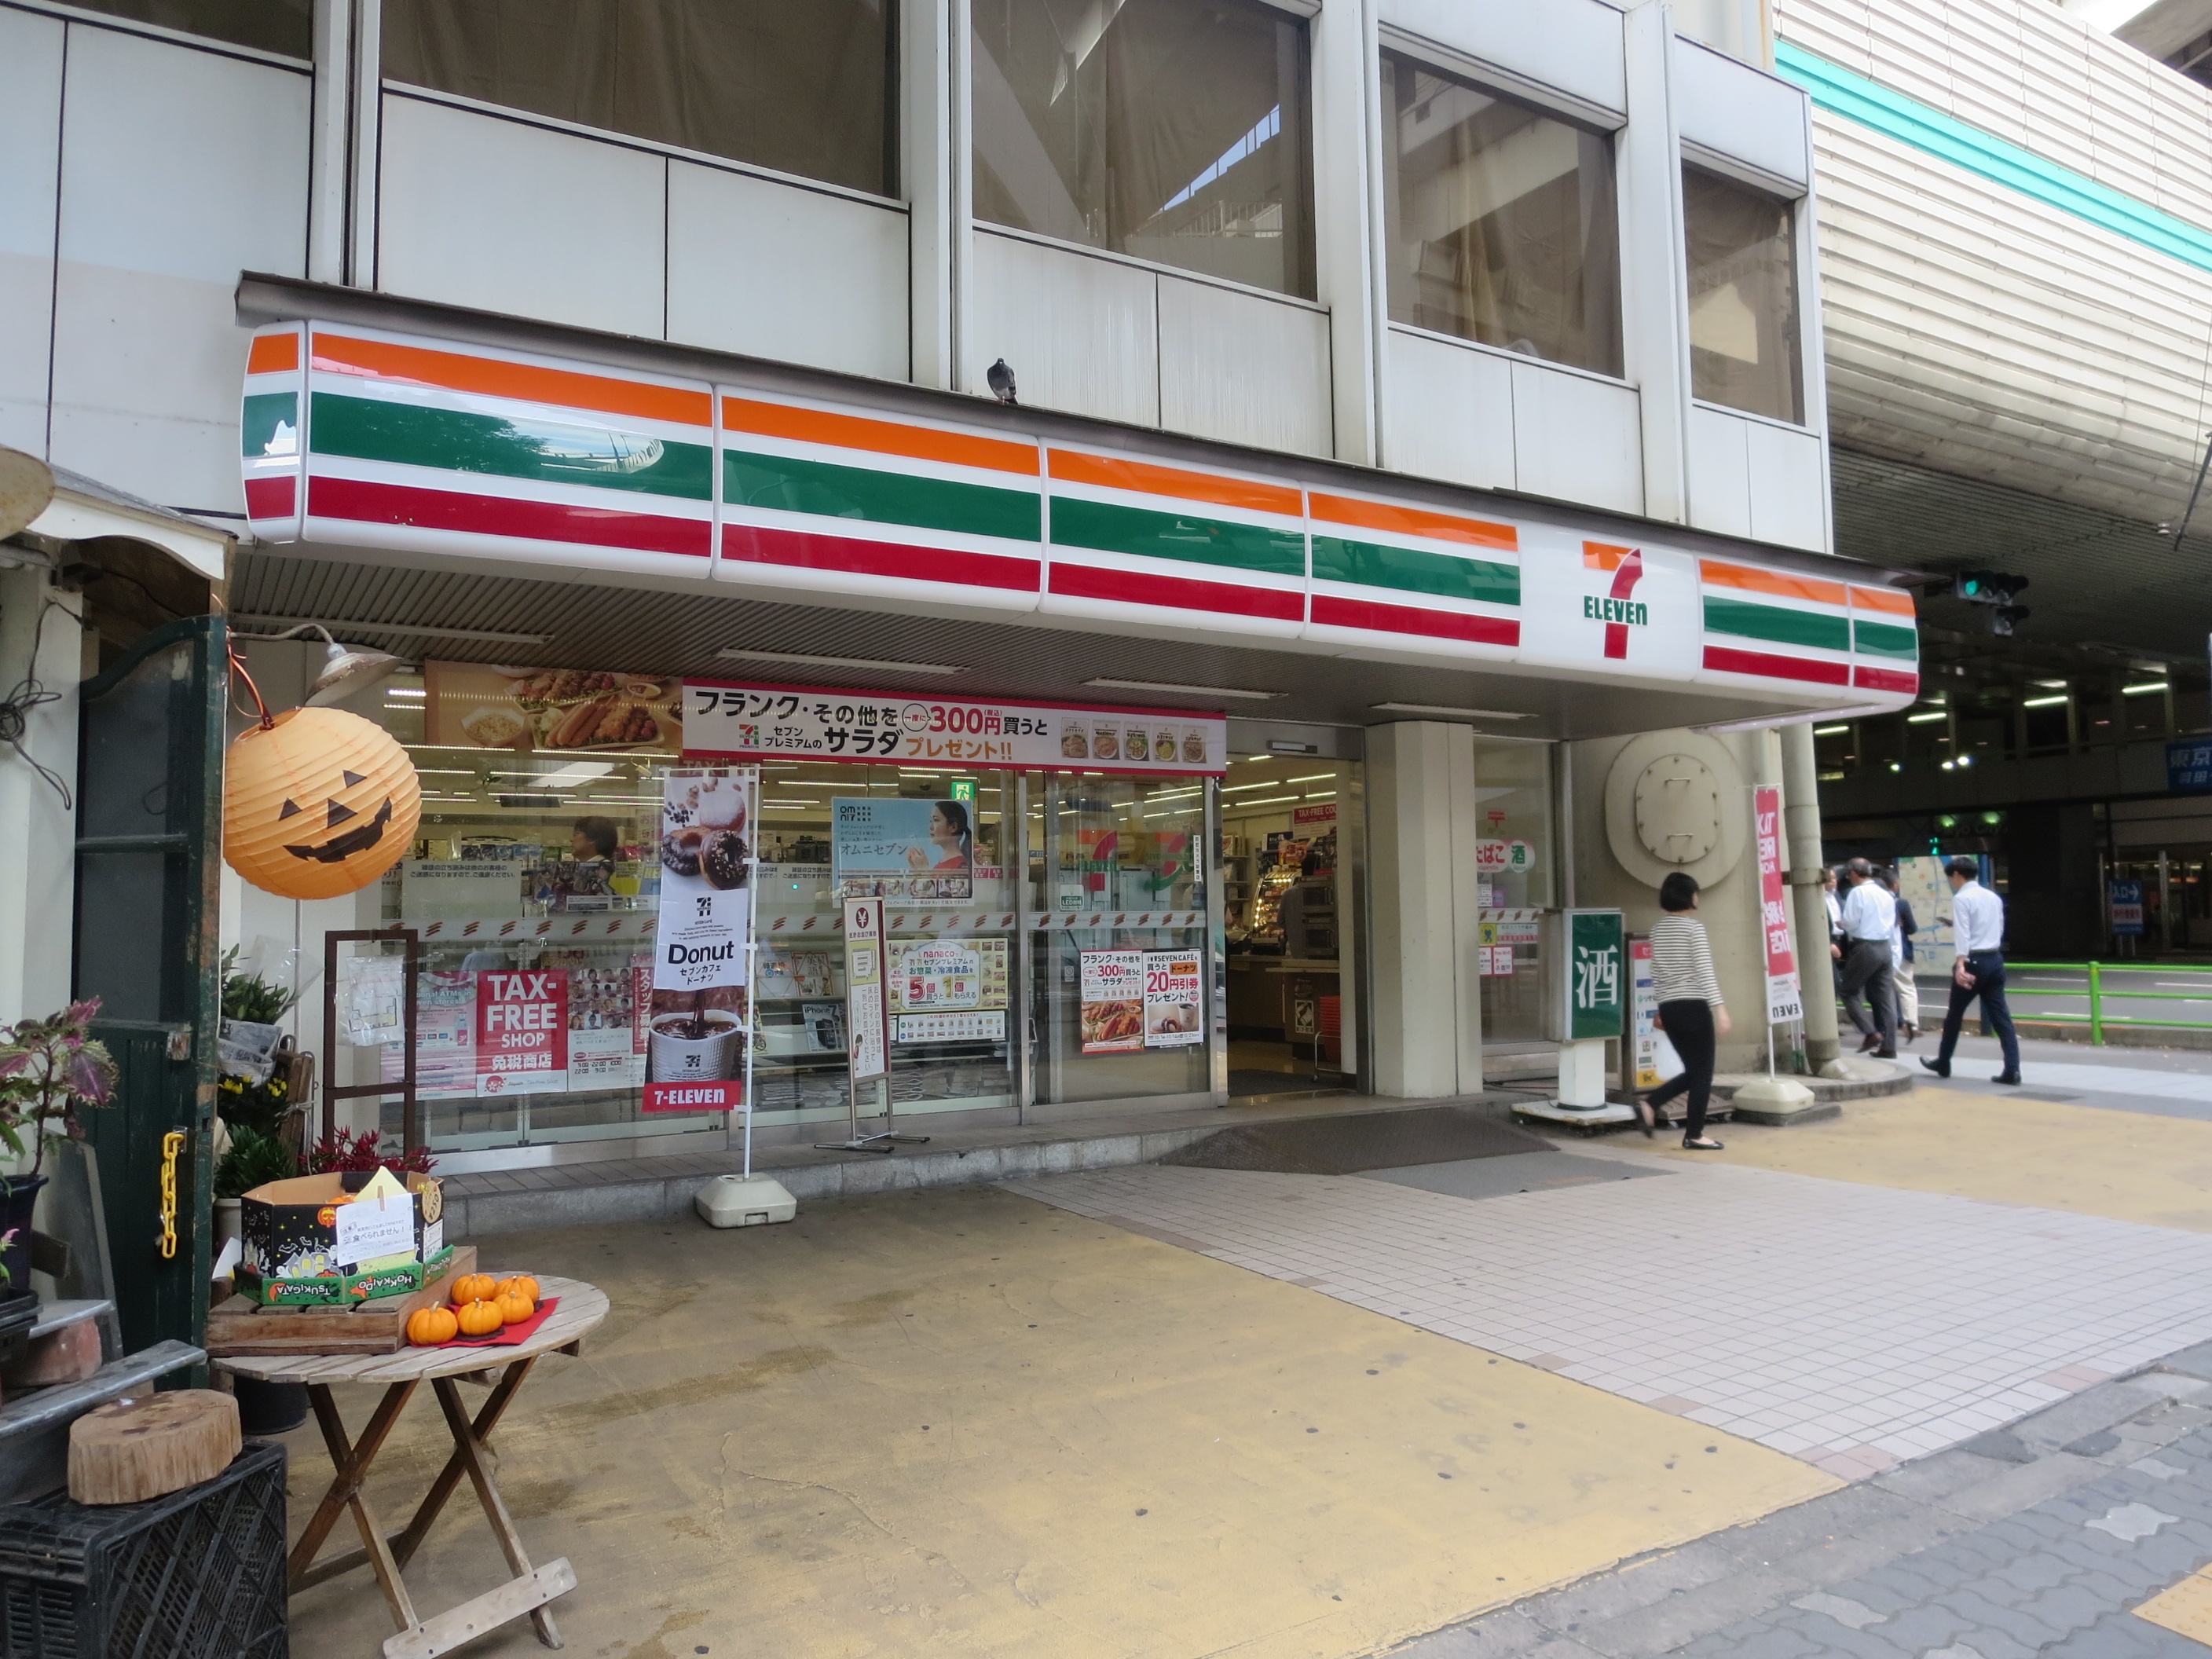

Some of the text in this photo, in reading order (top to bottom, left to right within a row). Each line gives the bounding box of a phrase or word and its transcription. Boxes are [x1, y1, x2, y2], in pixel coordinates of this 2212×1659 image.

[695, 690, 897, 727] フランク・その他を
[764, 736, 822, 749] プレミアムの
[774, 726, 803, 736] セブン
[824, 727, 904, 756] サラダ
[840, 843, 908, 855] オムニセブン
[668, 941, 734, 965] Donut
[680, 965, 721, 976] セブンカフェ
[1171, 964, 1196, 973] ドーナツ
[687, 974, 713, 986] ドーナツ
[1102, 977, 1122, 986] サラダ
[1576, 944, 1620, 1009] 酒
[487, 1002, 558, 1031] FREE
[501, 1032, 545, 1049] SHOP
[358, 1275, 412, 1290] HOKKAIDO
[276, 1285, 331, 1295] TSUKIGATA
